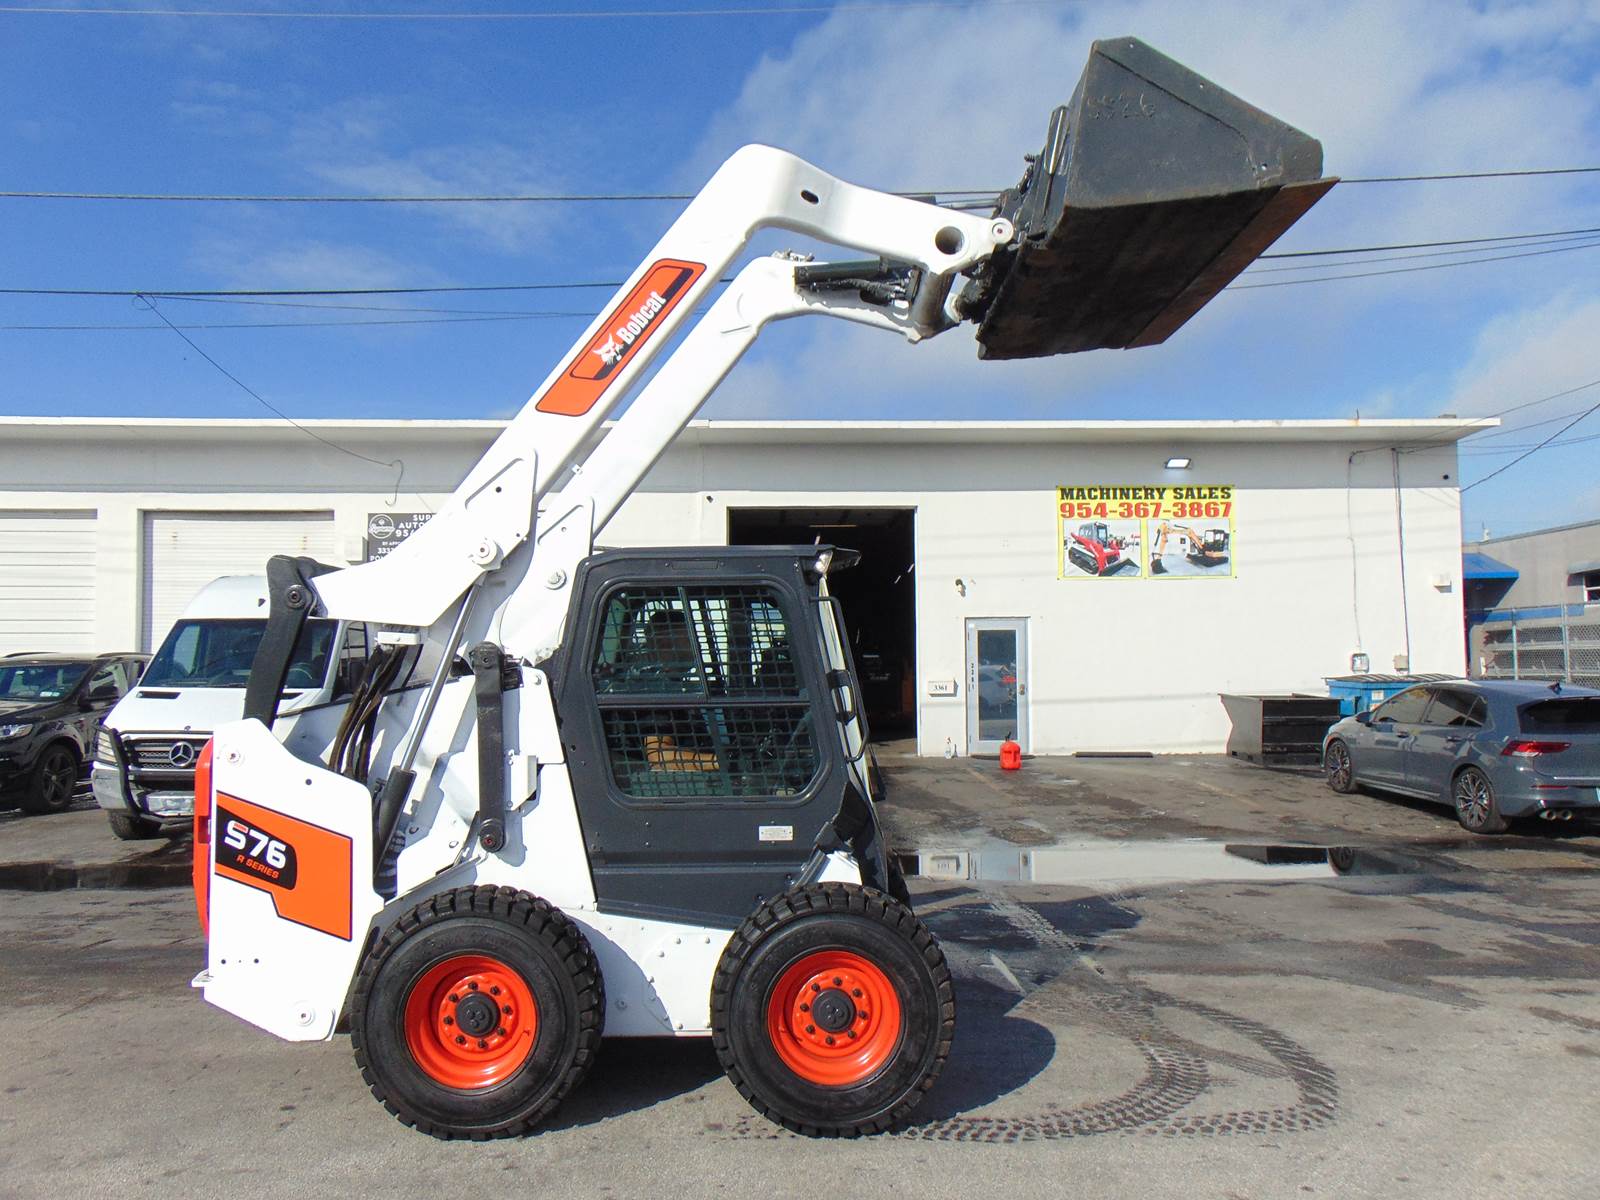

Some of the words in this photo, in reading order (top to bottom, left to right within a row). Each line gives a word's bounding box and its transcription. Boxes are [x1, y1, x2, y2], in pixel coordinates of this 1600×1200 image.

[616, 291, 667, 345] Bobcat
[1060, 487, 1166, 500] MACHINERY
[1173, 487, 1231, 499] SALES
[1060, 502, 1232, 518] 954-367-3867
[224, 820, 287, 869] S76
[246, 858, 279, 879] SERIES
